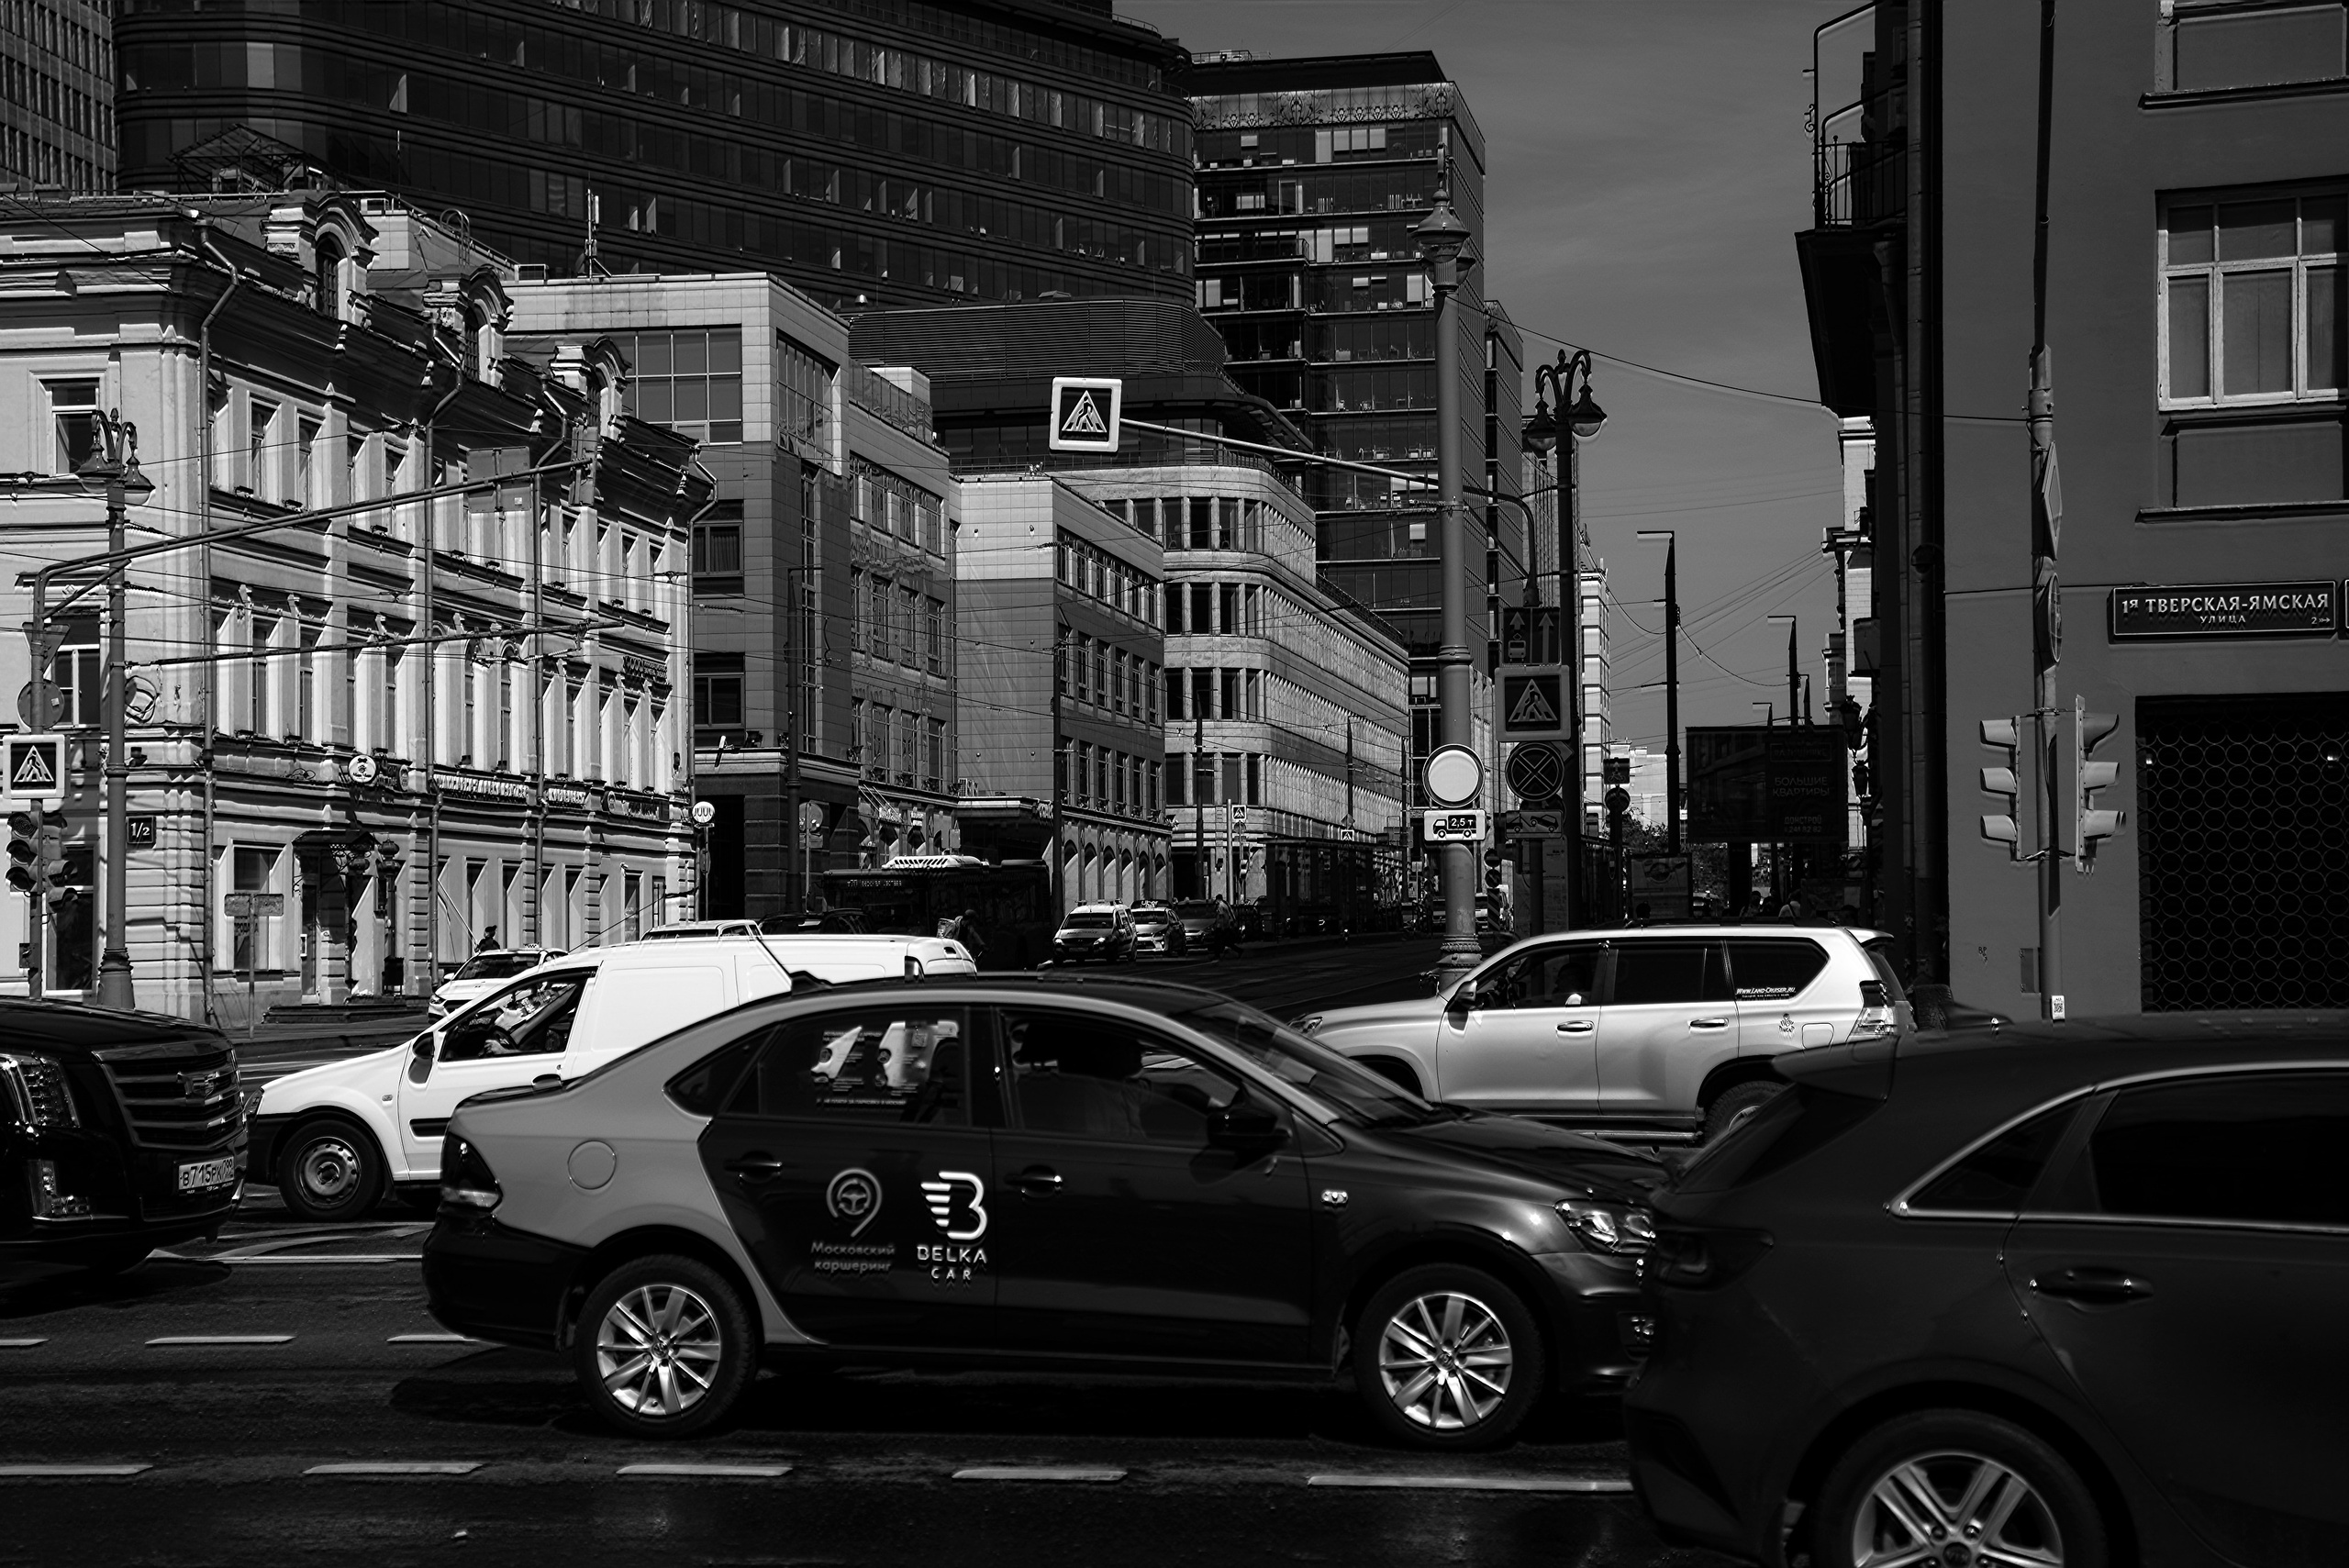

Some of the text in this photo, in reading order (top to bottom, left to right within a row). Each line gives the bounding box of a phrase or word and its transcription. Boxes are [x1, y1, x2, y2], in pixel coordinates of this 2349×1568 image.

[2145, 594, 2329, 613] ТВЕРСКАЯ-ЯМСКАЯ
[2199, 615, 2246, 624] УЛИЦА
[2311, 617, 2318, 625] 2
[1775, 776, 1829, 786] БОЛЬШИЕ
[1773, 787, 1831, 797] КВАРТИРЫ
[1451, 817, 1466, 828] 2,5
[130, 822, 150, 838] 1/2
[810, 1240, 896, 1256] Московский
[917, 1246, 987, 1263] BELKA
[814, 1261, 892, 1274] каршеринг
[930, 1267, 972, 1281] CAR
